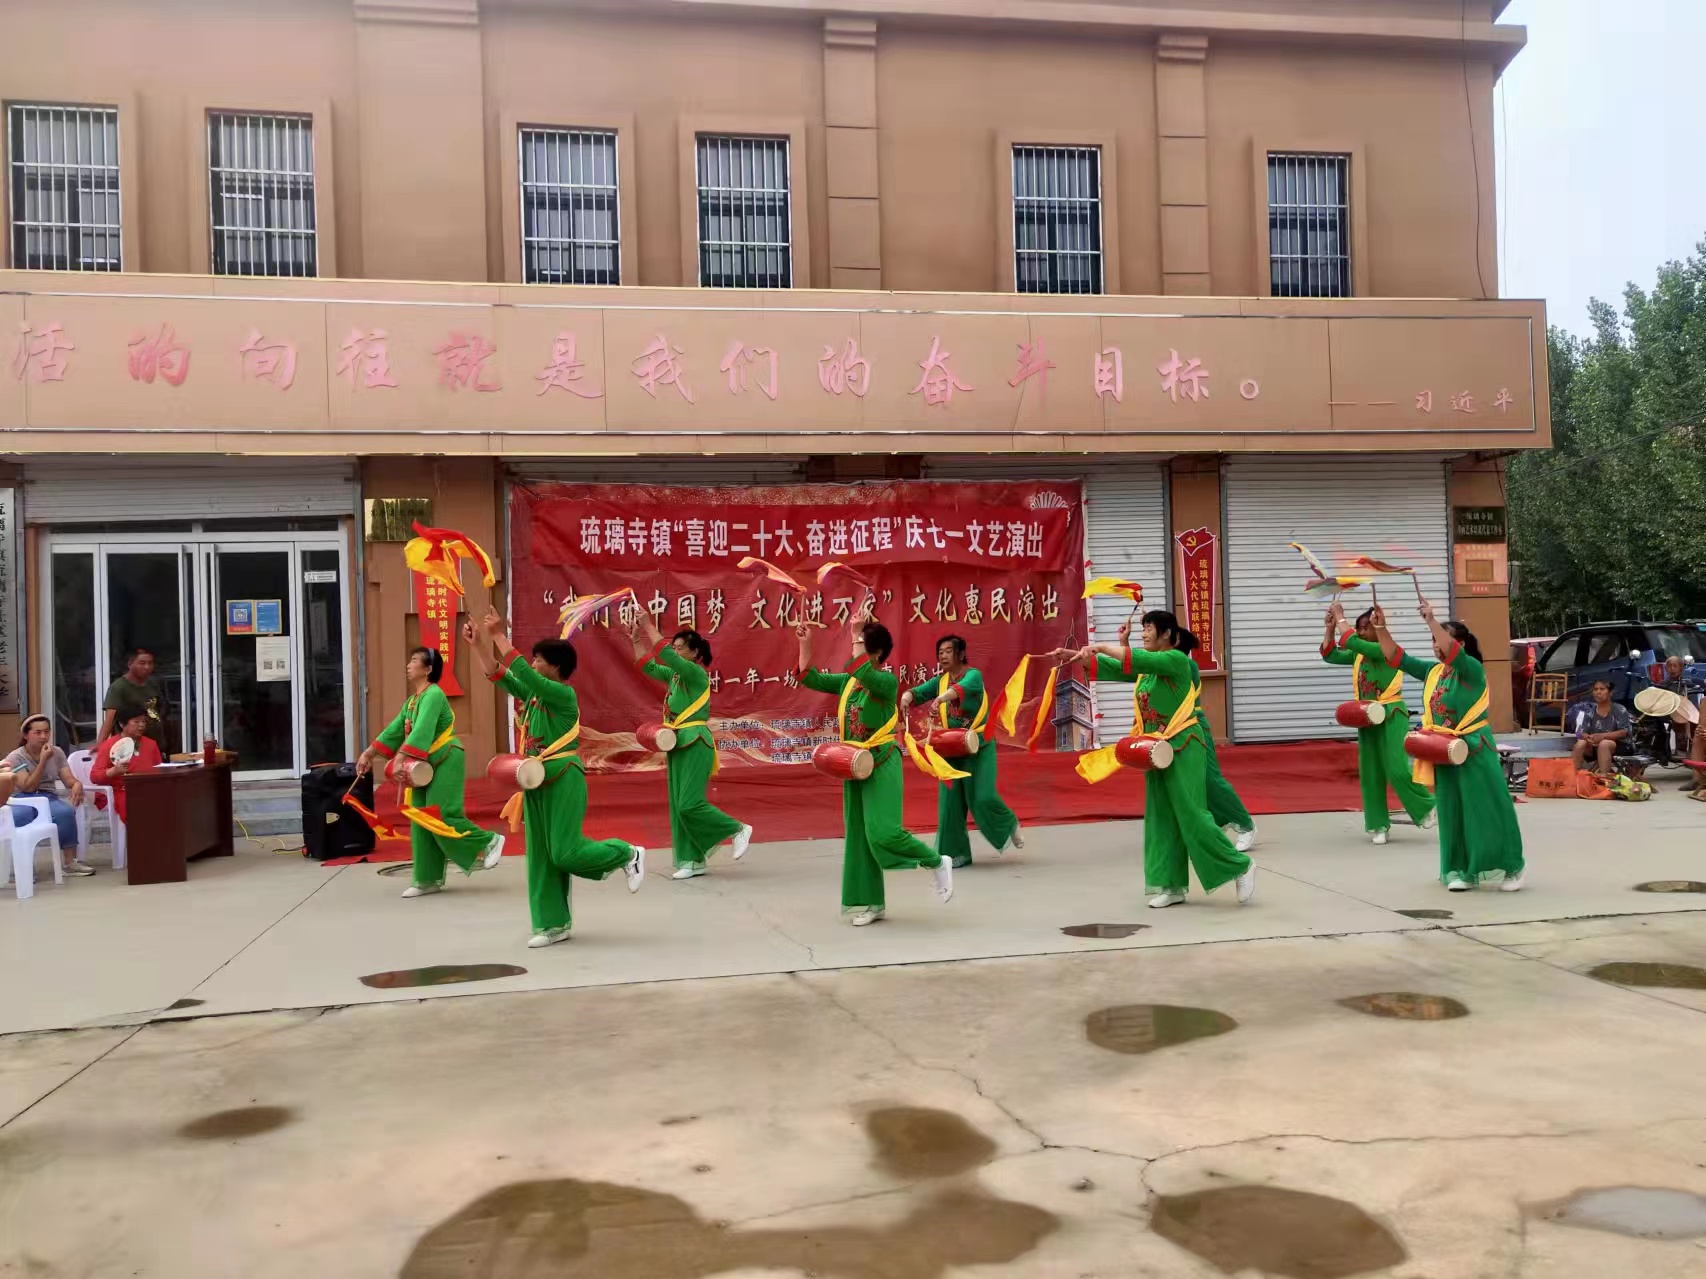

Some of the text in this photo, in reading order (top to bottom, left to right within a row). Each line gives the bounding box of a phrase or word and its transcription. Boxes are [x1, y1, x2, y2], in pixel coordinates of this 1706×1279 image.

[580, 514, 1043, 558] 琉璃寺镇“喜迎二十大、奋进征程”庆七一文艺演出
[908, 584, 1060, 625] 文化惠民演出
[1189, 570, 1200, 639] 人大代表联络
